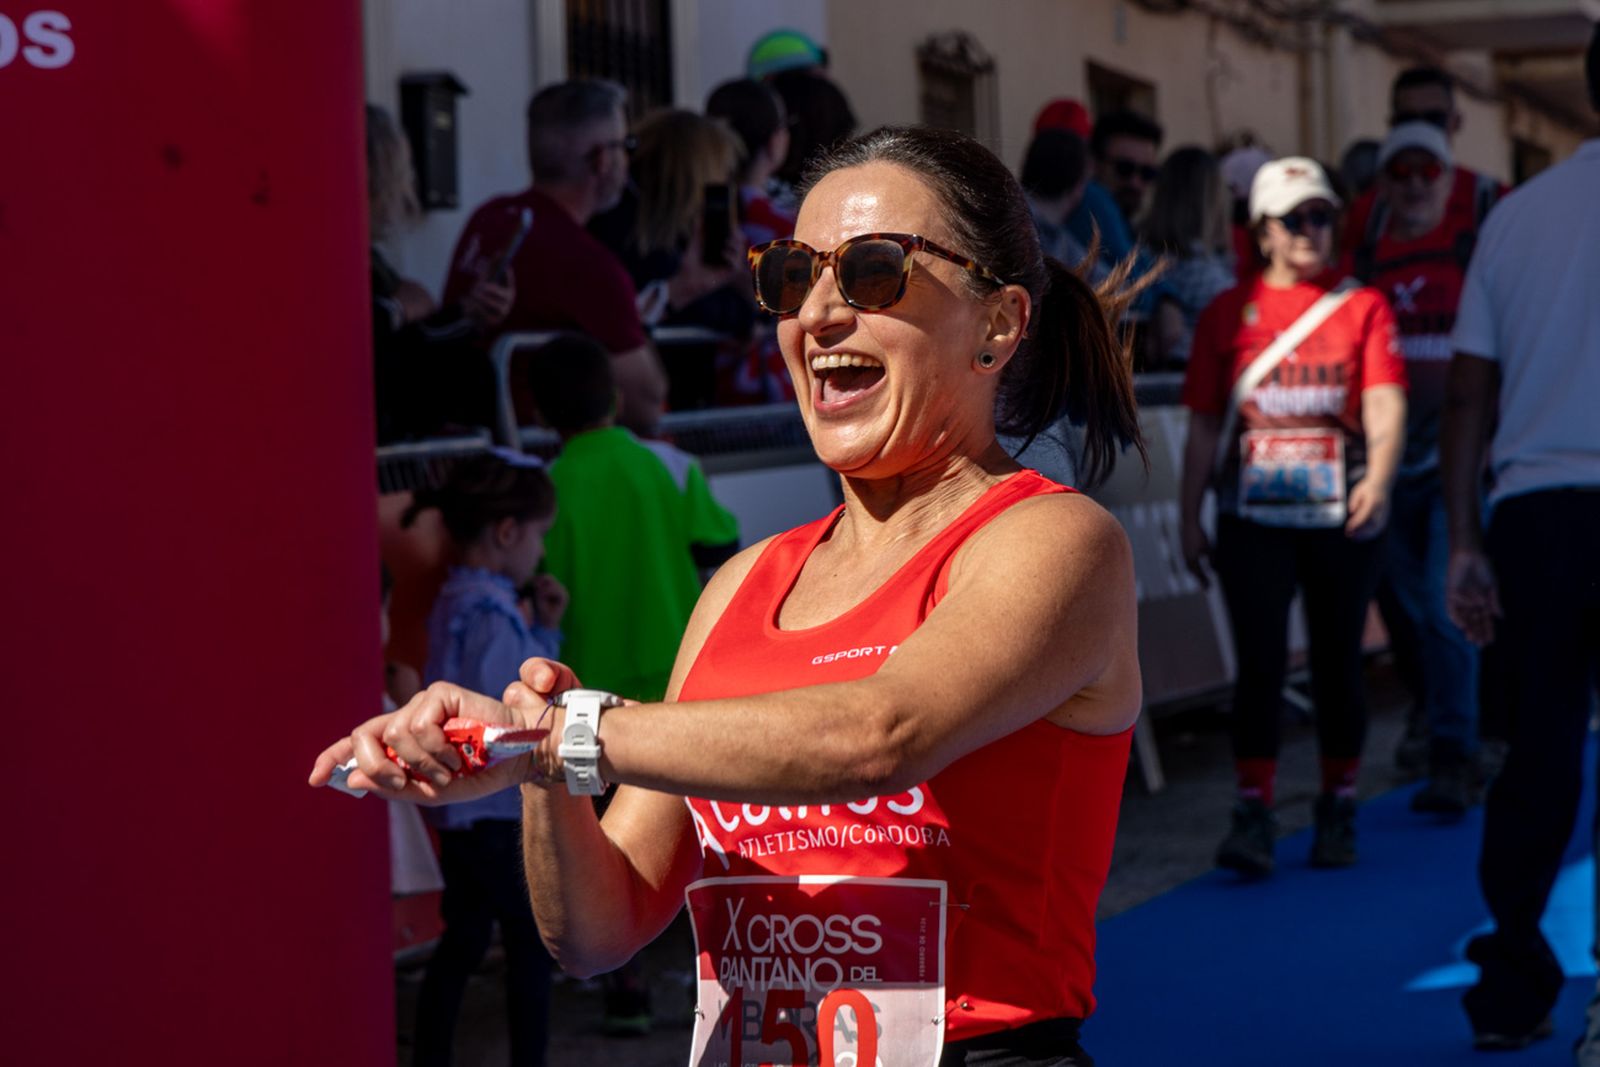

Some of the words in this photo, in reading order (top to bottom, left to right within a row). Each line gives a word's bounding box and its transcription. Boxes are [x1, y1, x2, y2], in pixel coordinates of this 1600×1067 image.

[811, 645, 886, 665] GSPORT
[722, 897, 744, 951] X
[747, 914, 883, 955] CROSS
[719, 957, 844, 992] PANTANO
[850, 966, 883, 982] DEL
[721, 986, 878, 1067] 150
